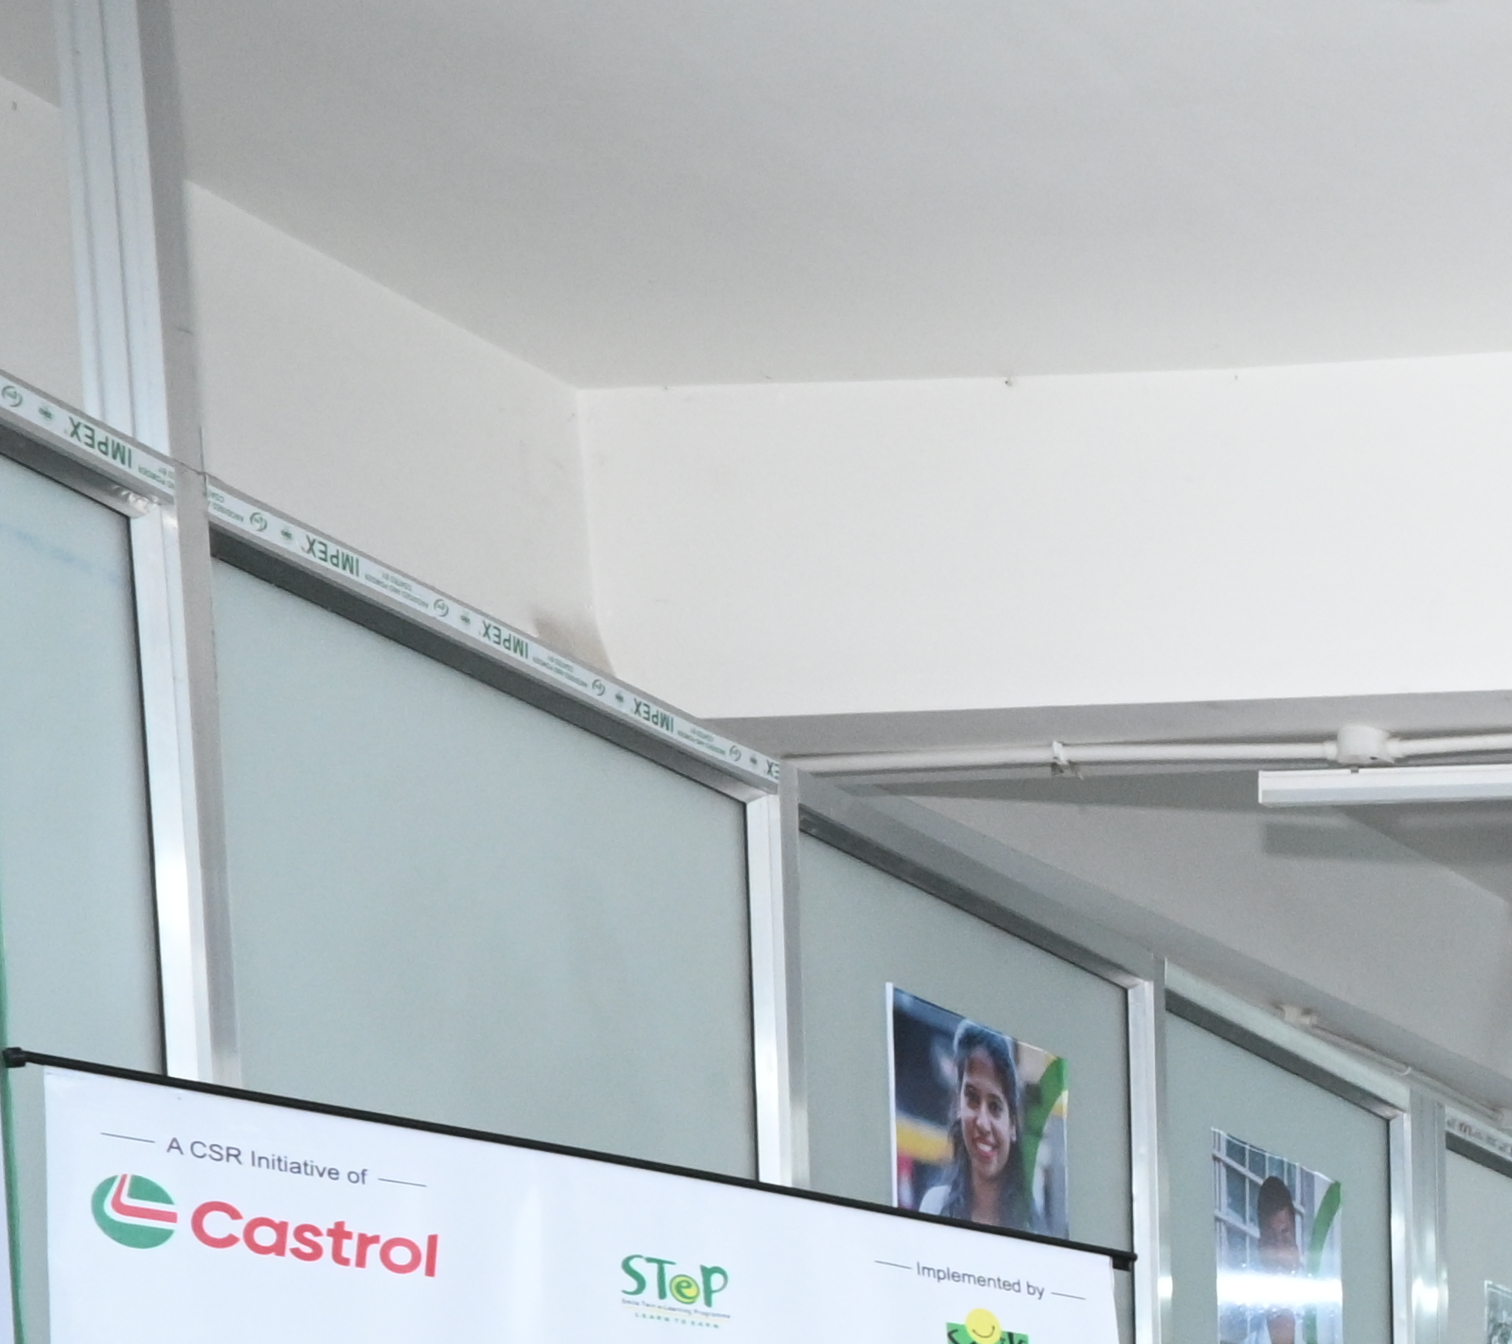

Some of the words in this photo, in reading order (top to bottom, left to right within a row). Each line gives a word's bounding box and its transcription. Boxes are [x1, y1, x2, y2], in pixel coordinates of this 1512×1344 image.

[68, 416, 132, 469] IMPEX
[305, 533, 359, 577] IMPEX
[481, 620, 529, 659] IMPEX
[633, 697, 674, 733] IMPEX
[166, 1137, 184, 1155] A
[190, 1140, 243, 1165] CSR
[251, 1150, 340, 1180] Initiative
[347, 1168, 369, 1185] of
[191, 1200, 439, 1278] Castrol
[916, 1262, 1022, 1293] Implemented
[1026, 1281, 1045, 1300] by
